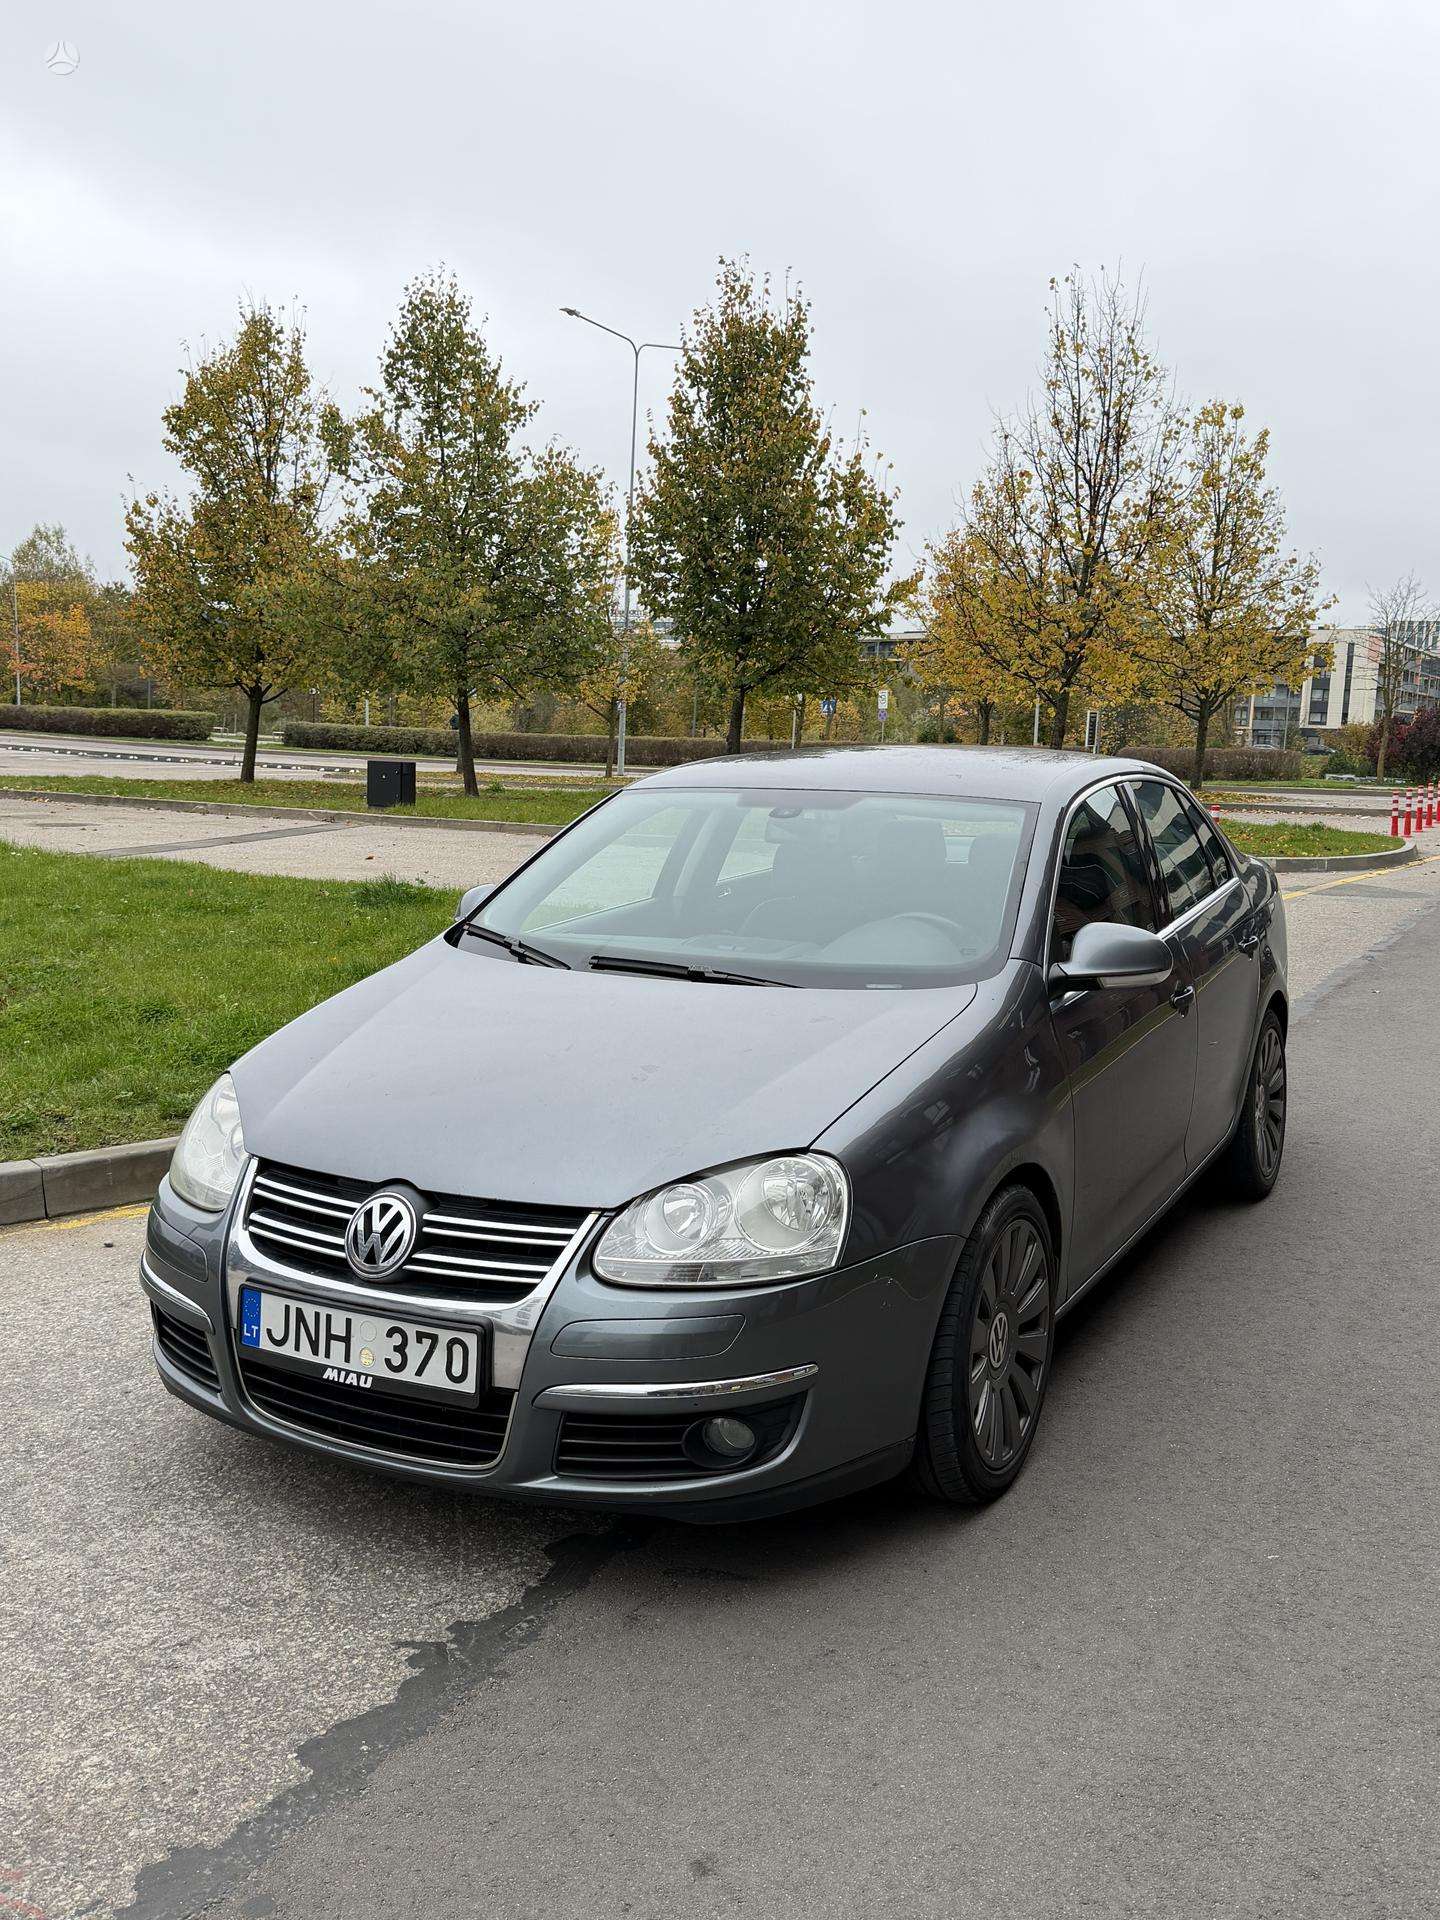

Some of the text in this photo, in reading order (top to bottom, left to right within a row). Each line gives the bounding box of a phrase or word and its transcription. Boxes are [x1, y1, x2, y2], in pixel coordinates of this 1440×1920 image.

[350, 1197, 409, 1270] VW
[244, 1323, 259, 1338] LT
[266, 1304, 469, 1384] JNH 370
[323, 1367, 373, 1389] MIAU
